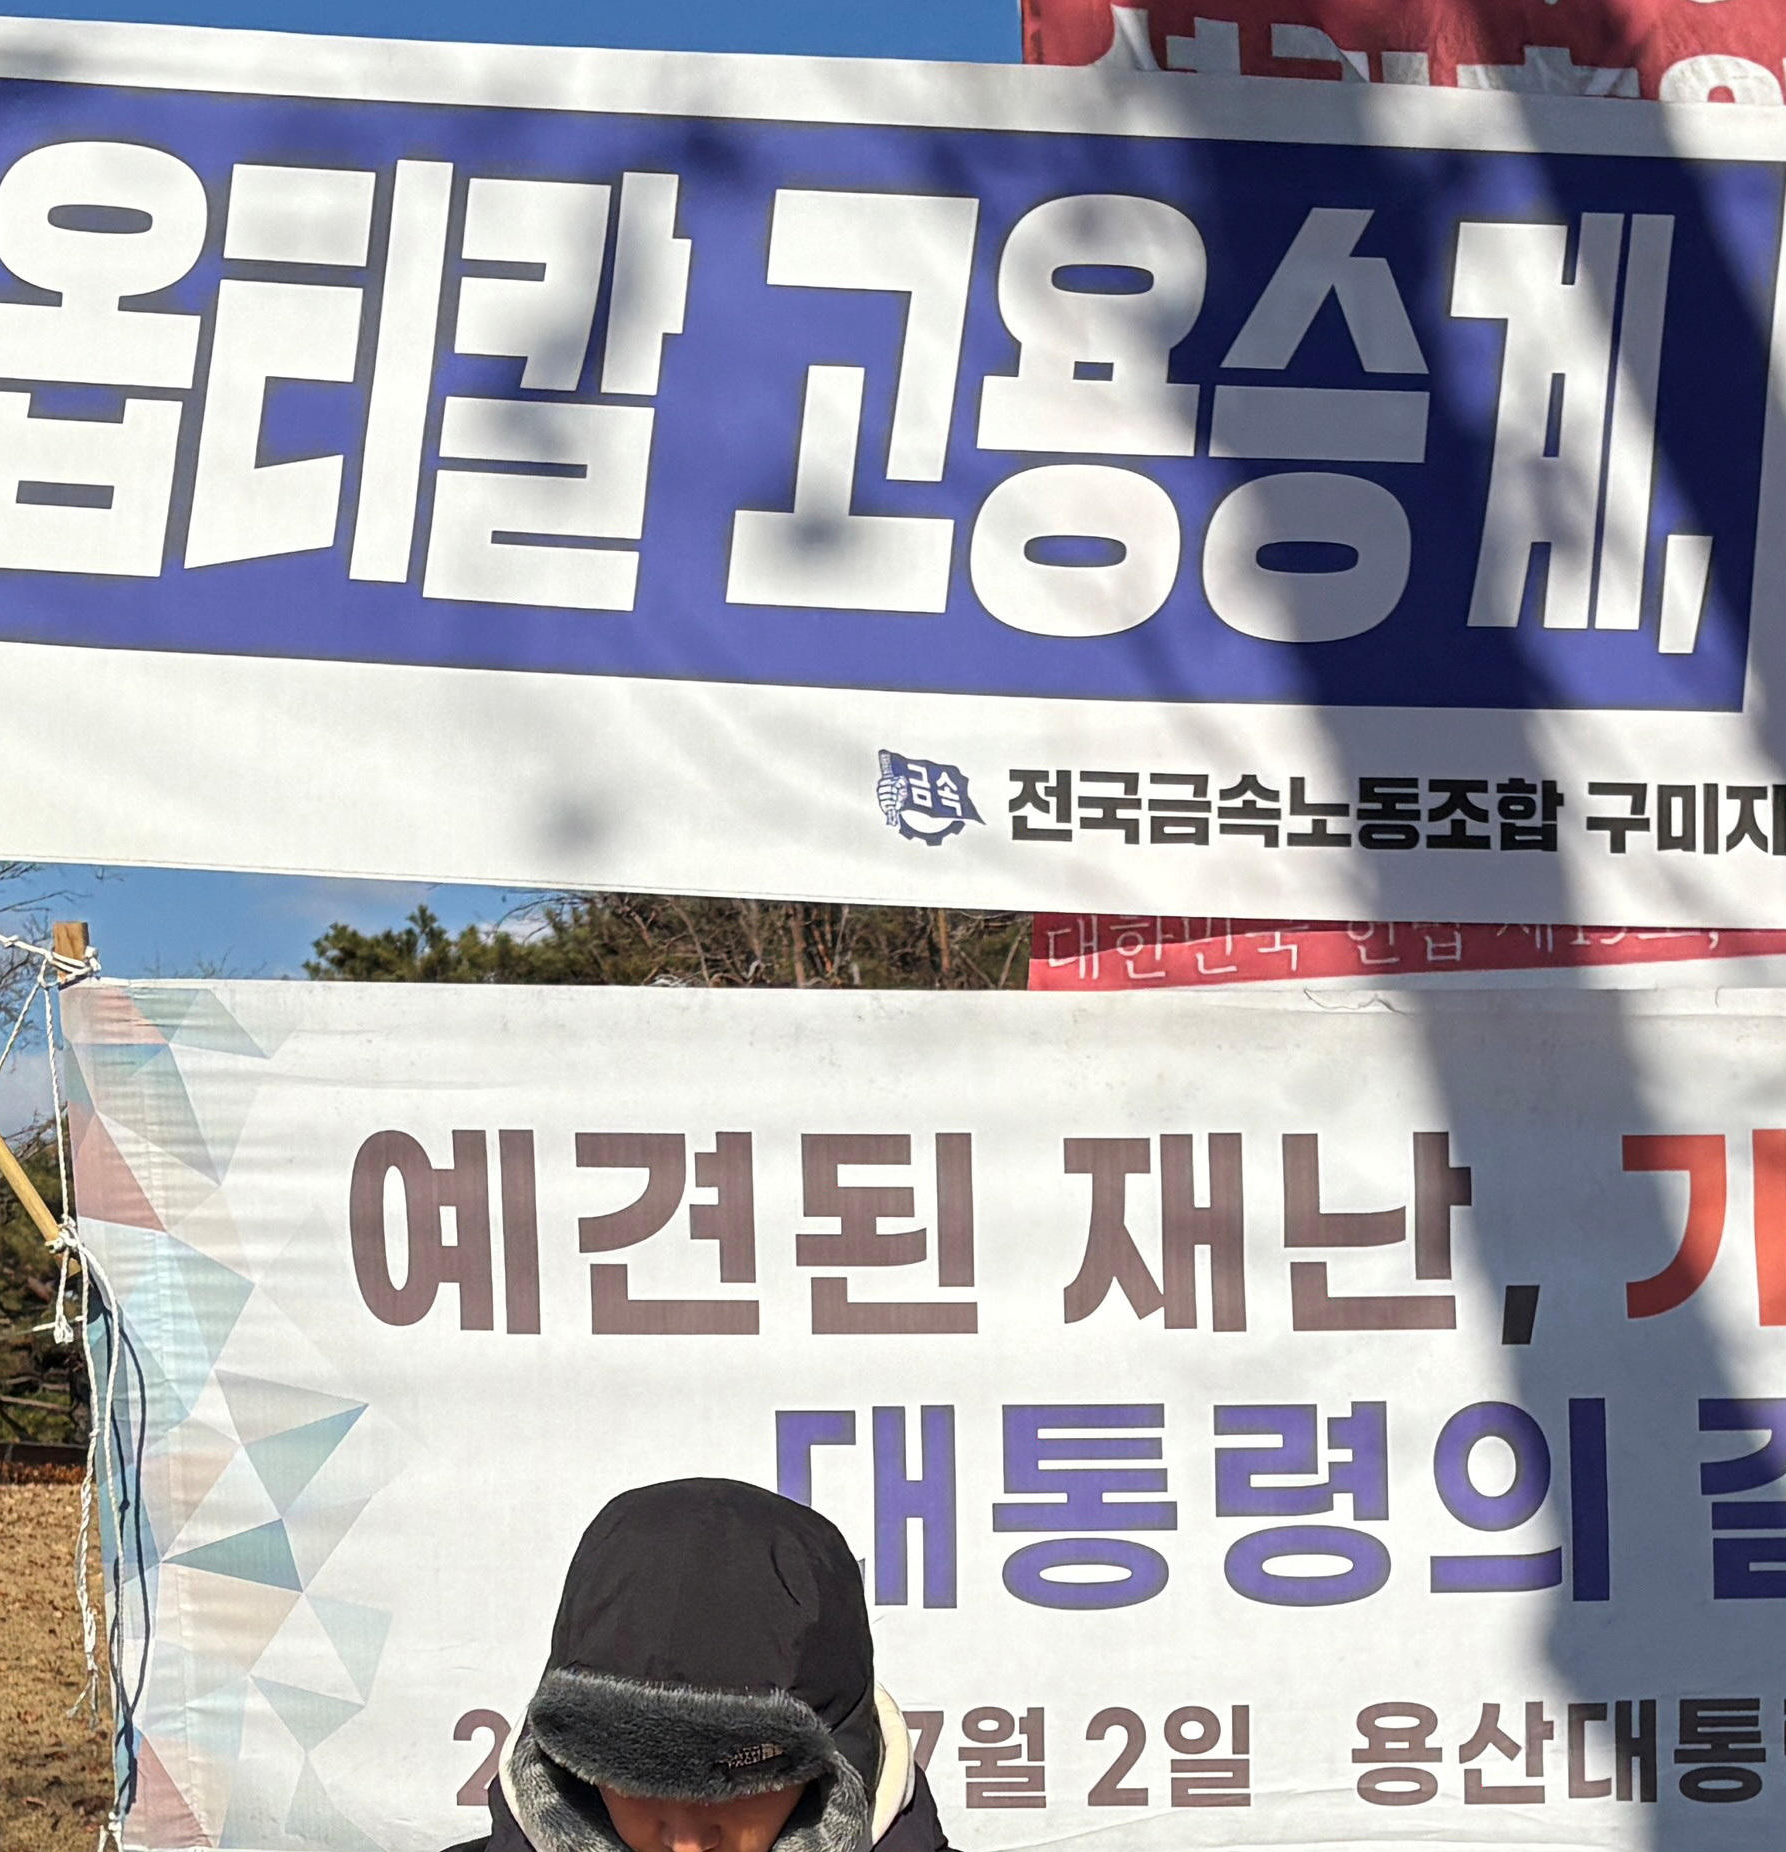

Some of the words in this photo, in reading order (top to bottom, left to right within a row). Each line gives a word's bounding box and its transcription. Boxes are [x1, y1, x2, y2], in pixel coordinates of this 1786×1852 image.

[725, 190, 1712, 654] 고용승계,
[906, 760, 964, 820] 금속
[1008, 767, 1562, 854] 전국금속노동조합
[349, 1129, 980, 1336] 예견된
[1061, 1129, 1540, 1346] 재난,
[774, 1396, 1612, 1611] 대통령의
[1085, 1704, 1252, 1811] 2일
